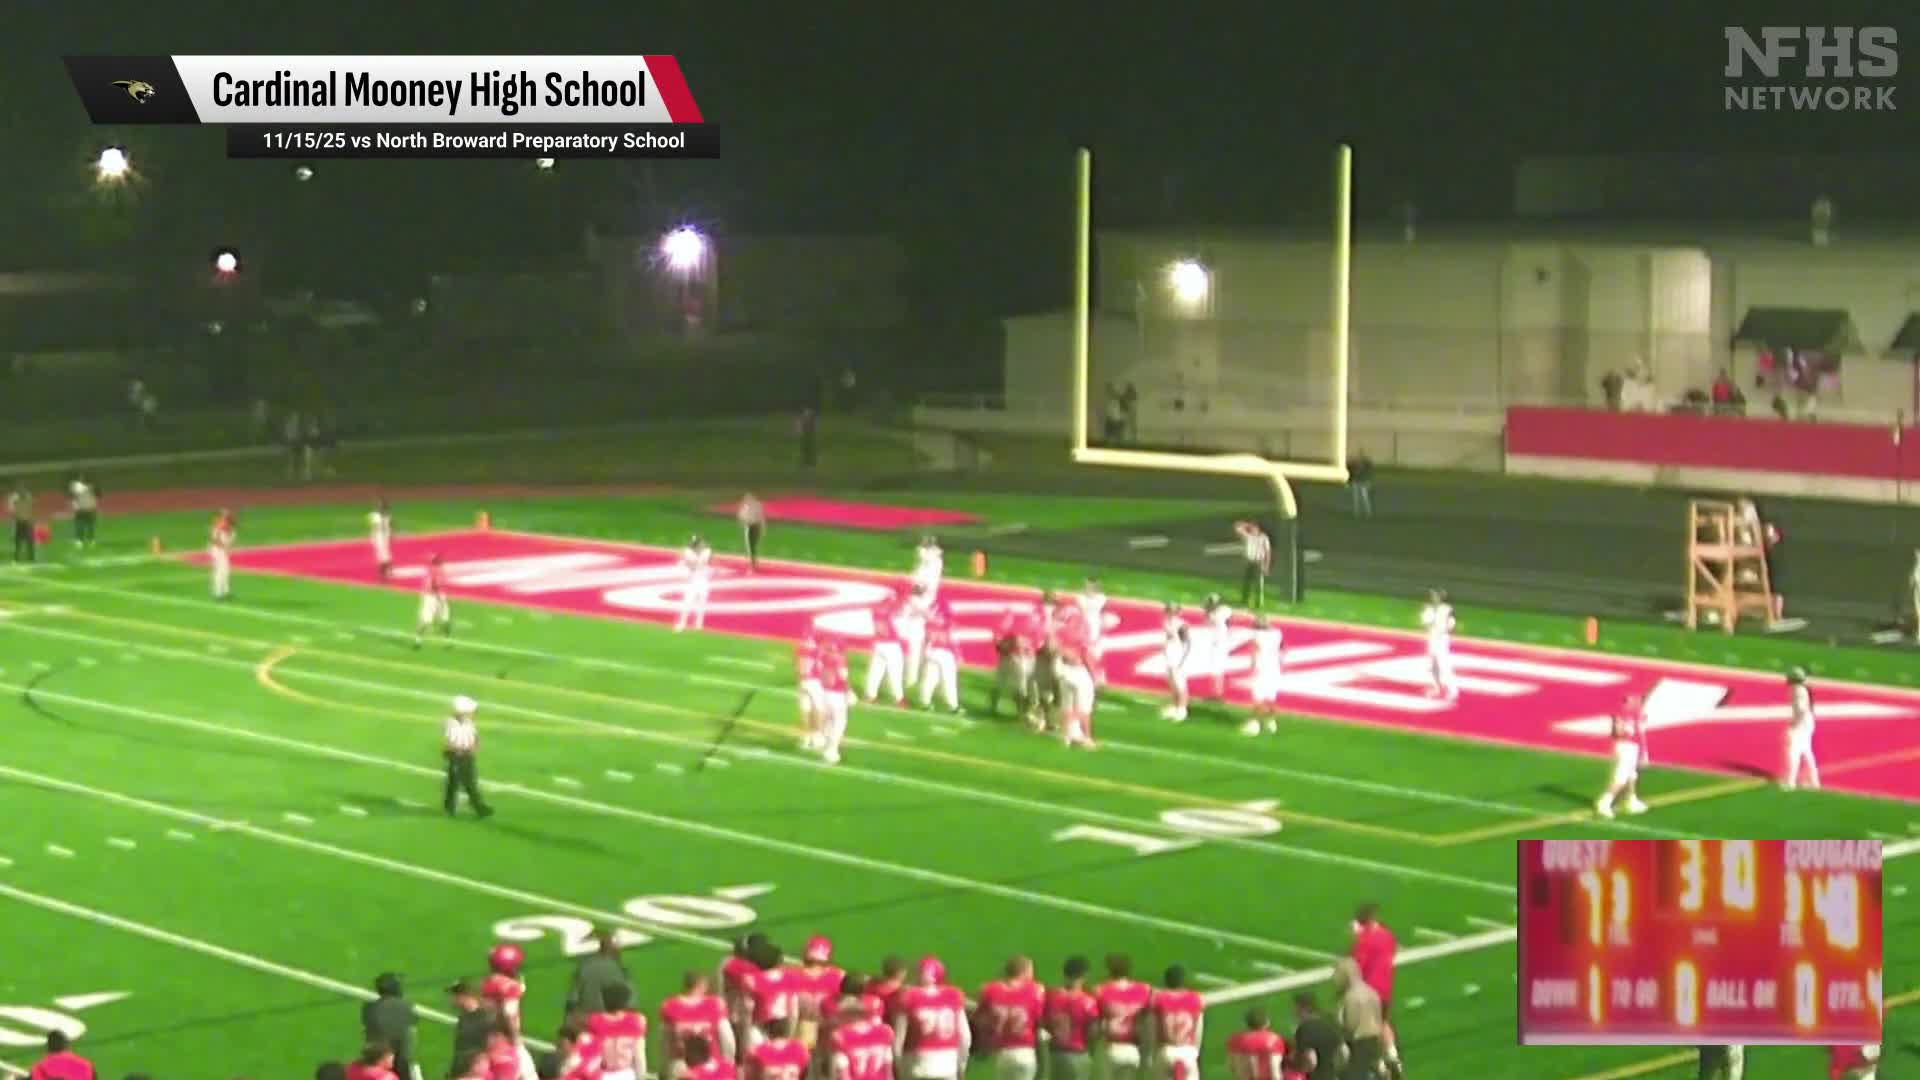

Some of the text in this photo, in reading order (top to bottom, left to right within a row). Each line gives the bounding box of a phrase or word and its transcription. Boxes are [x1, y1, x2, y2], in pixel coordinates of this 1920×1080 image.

[1052, 808, 1283, 857] 10
[1784, 840, 1882, 869] COUGARS
[492, 894, 758, 957] 20
[1706, 977, 1748, 1009] BALL
